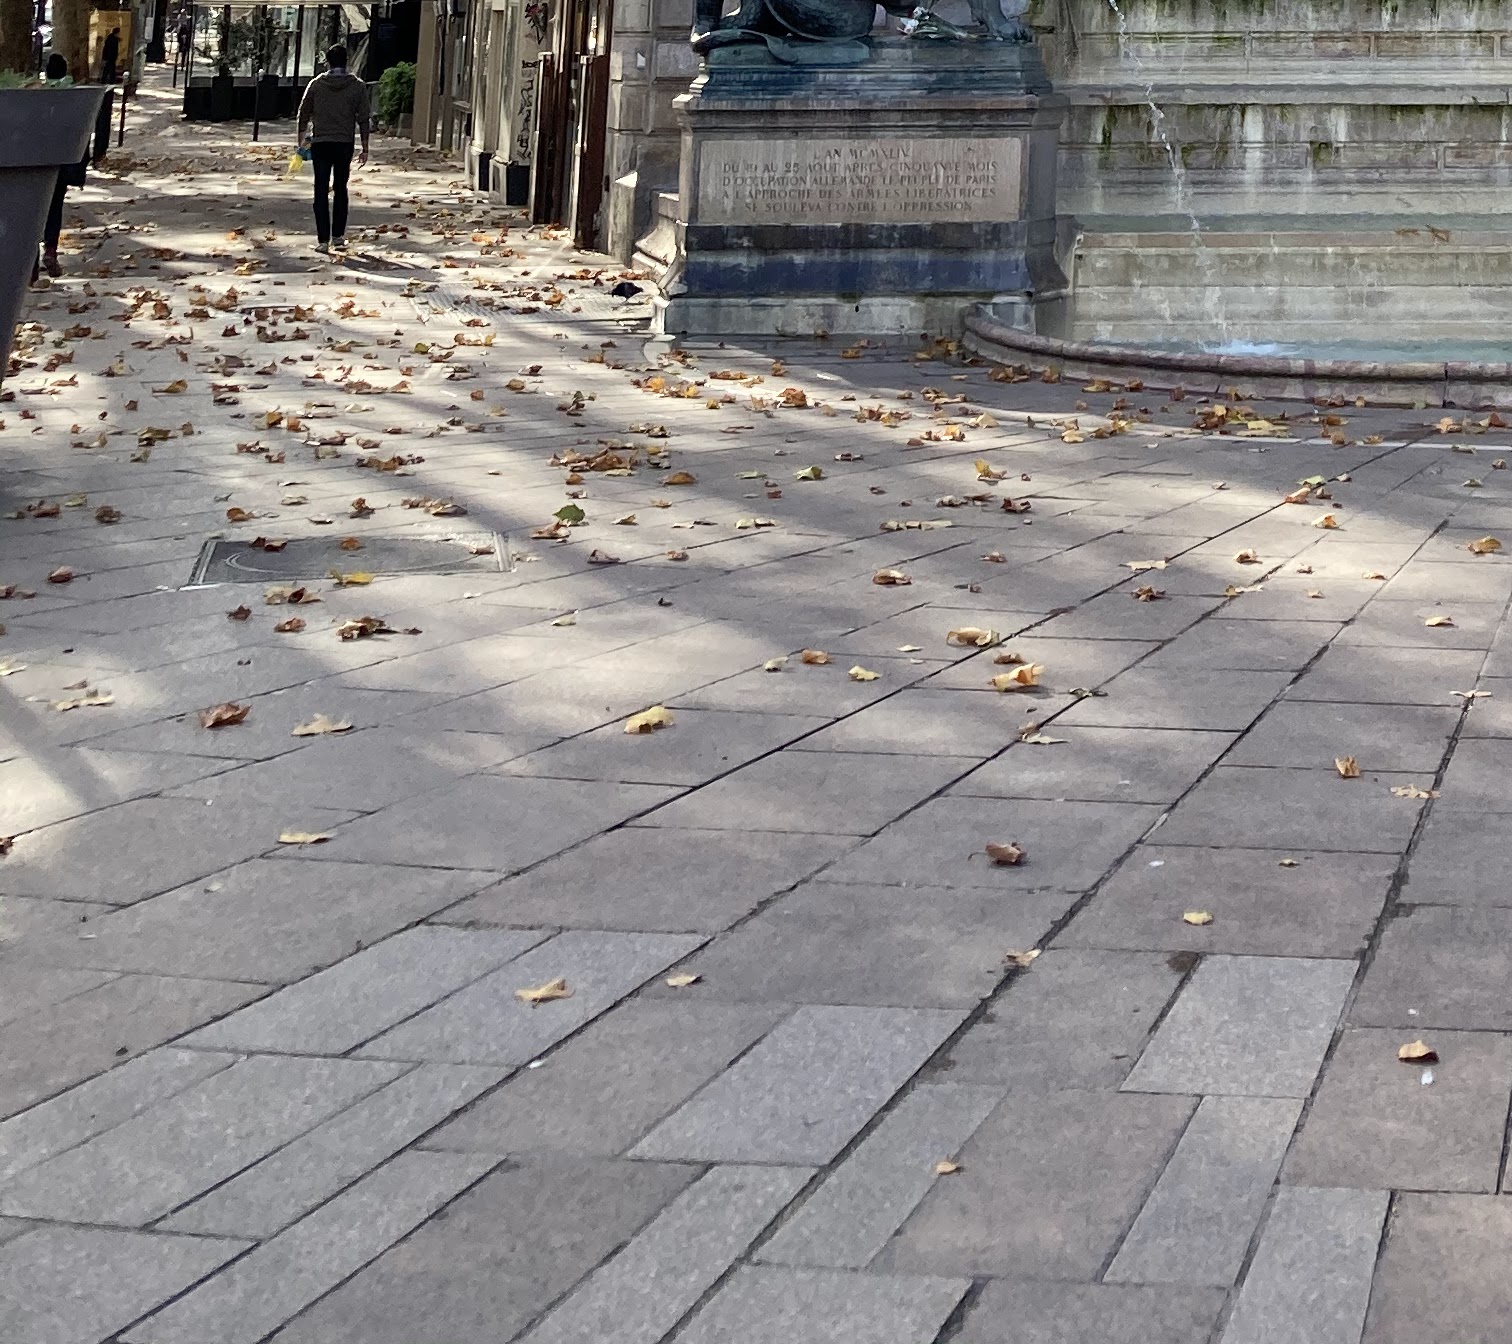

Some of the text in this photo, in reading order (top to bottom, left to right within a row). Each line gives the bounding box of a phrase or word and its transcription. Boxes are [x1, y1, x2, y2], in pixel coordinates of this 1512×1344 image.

[723, 163, 740, 173] DU
[762, 161, 778, 173] AU
[968, 160, 998, 172] MOIS
[946, 175, 961, 184] DE
[966, 175, 997, 185] PARIS
[819, 189, 843, 199] DES
[765, 202, 822, 213] SOULEVA
